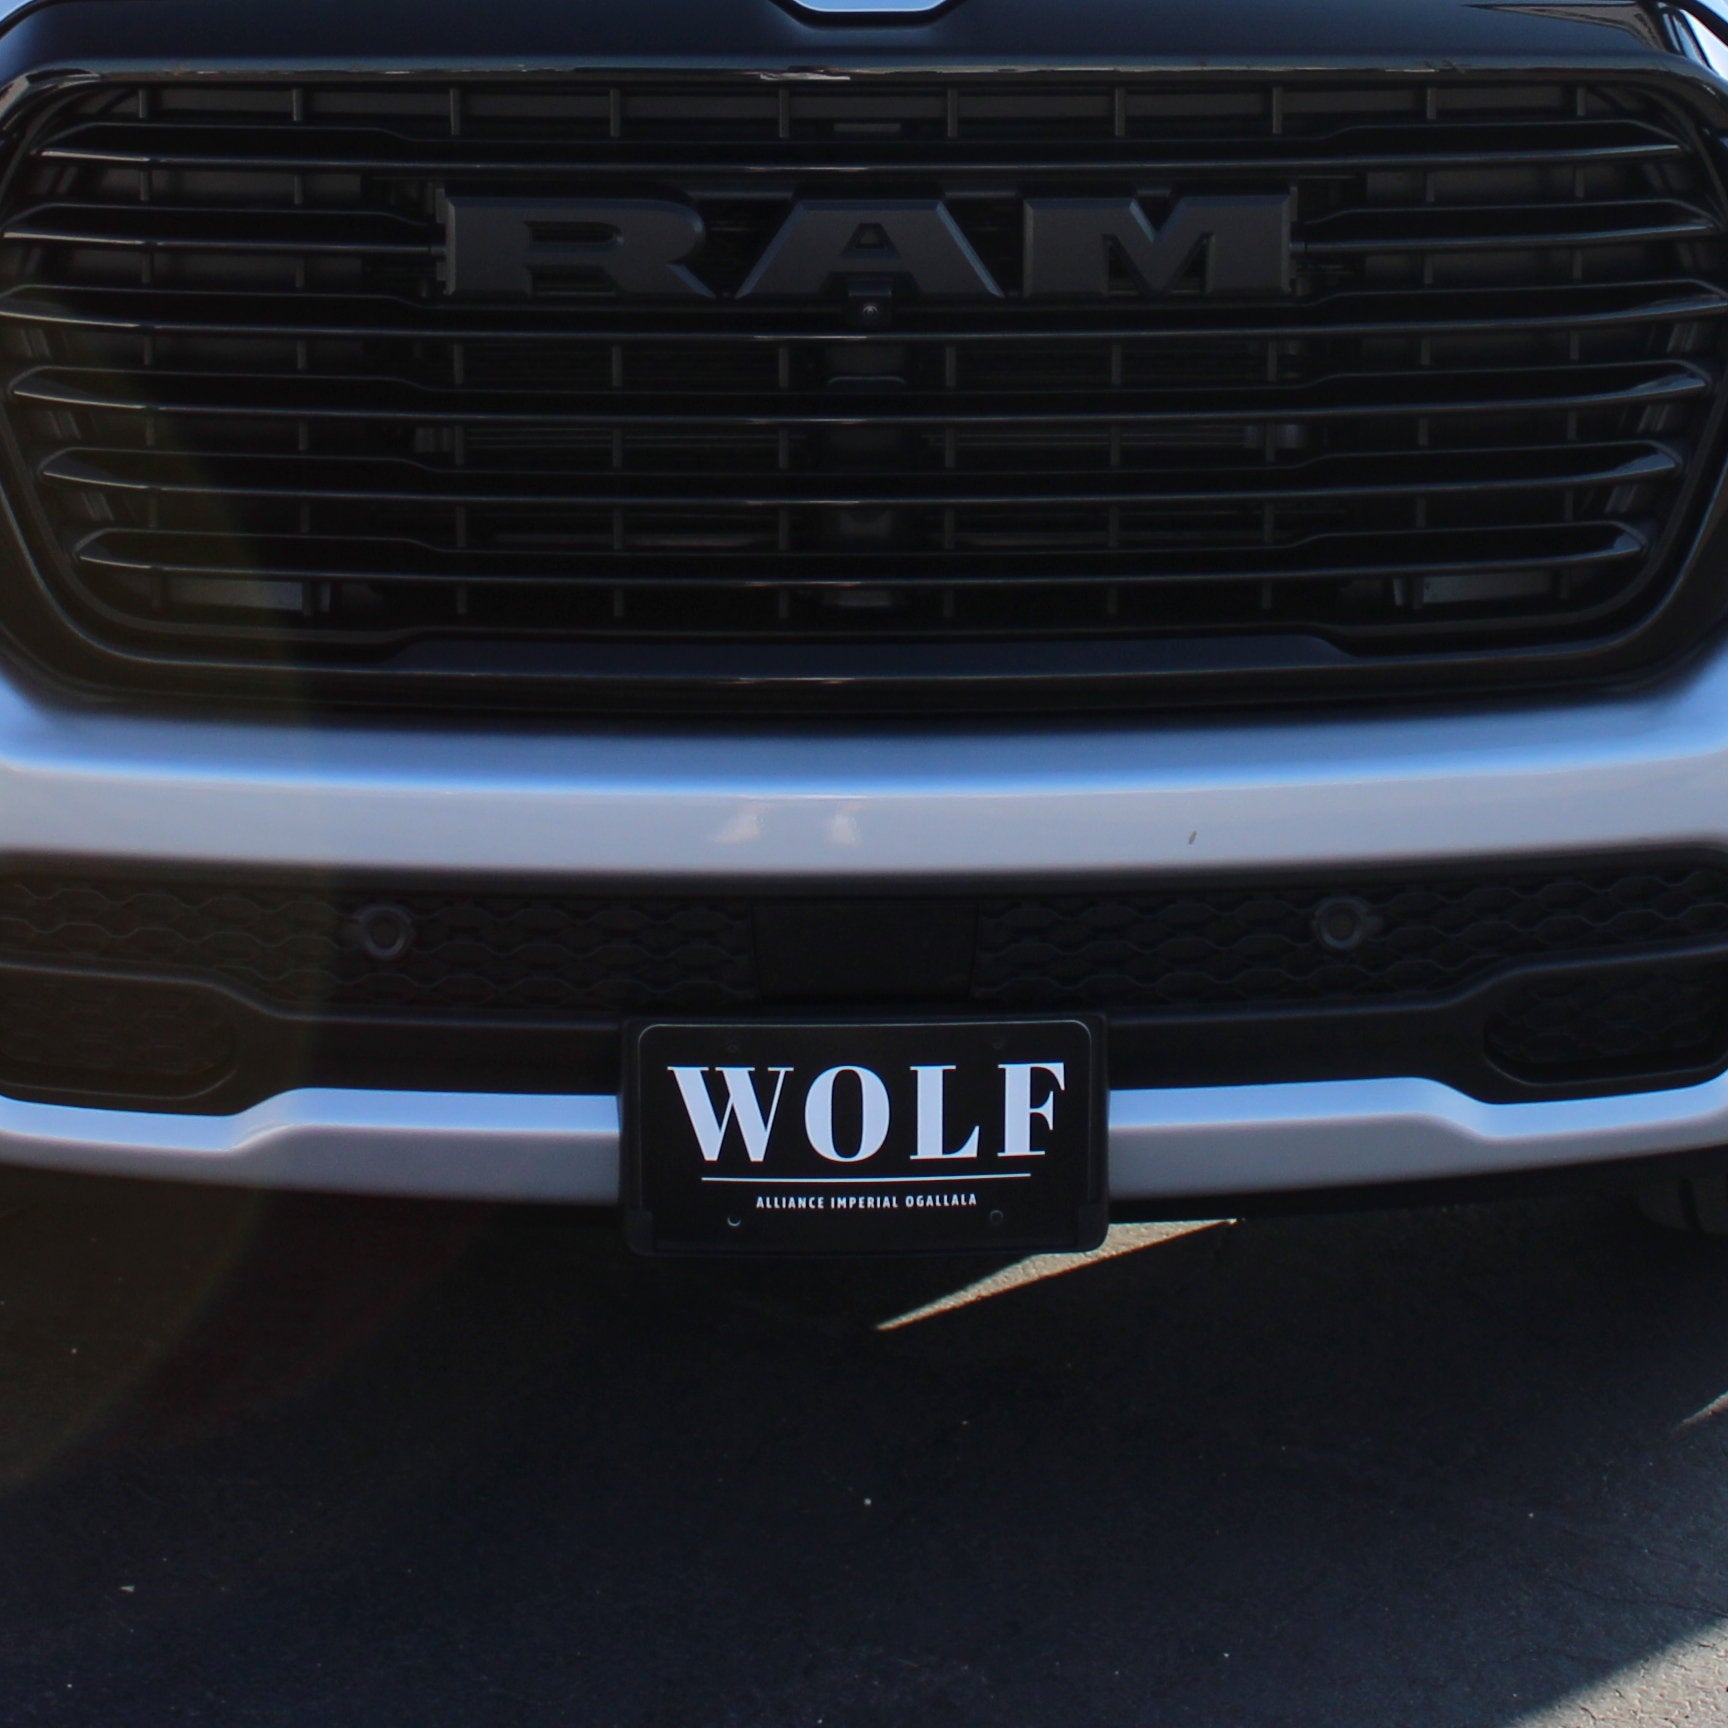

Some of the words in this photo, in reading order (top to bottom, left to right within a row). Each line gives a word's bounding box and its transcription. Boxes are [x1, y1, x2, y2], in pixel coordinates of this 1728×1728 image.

[444, 196, 1292, 299] RAM
[667, 1062, 1065, 1162] WOLF
[756, 1196, 824, 1209] ALLIANCE
[830, 1196, 899, 1209] IMPERIAL
[905, 1193, 977, 1208] OGALLALA
